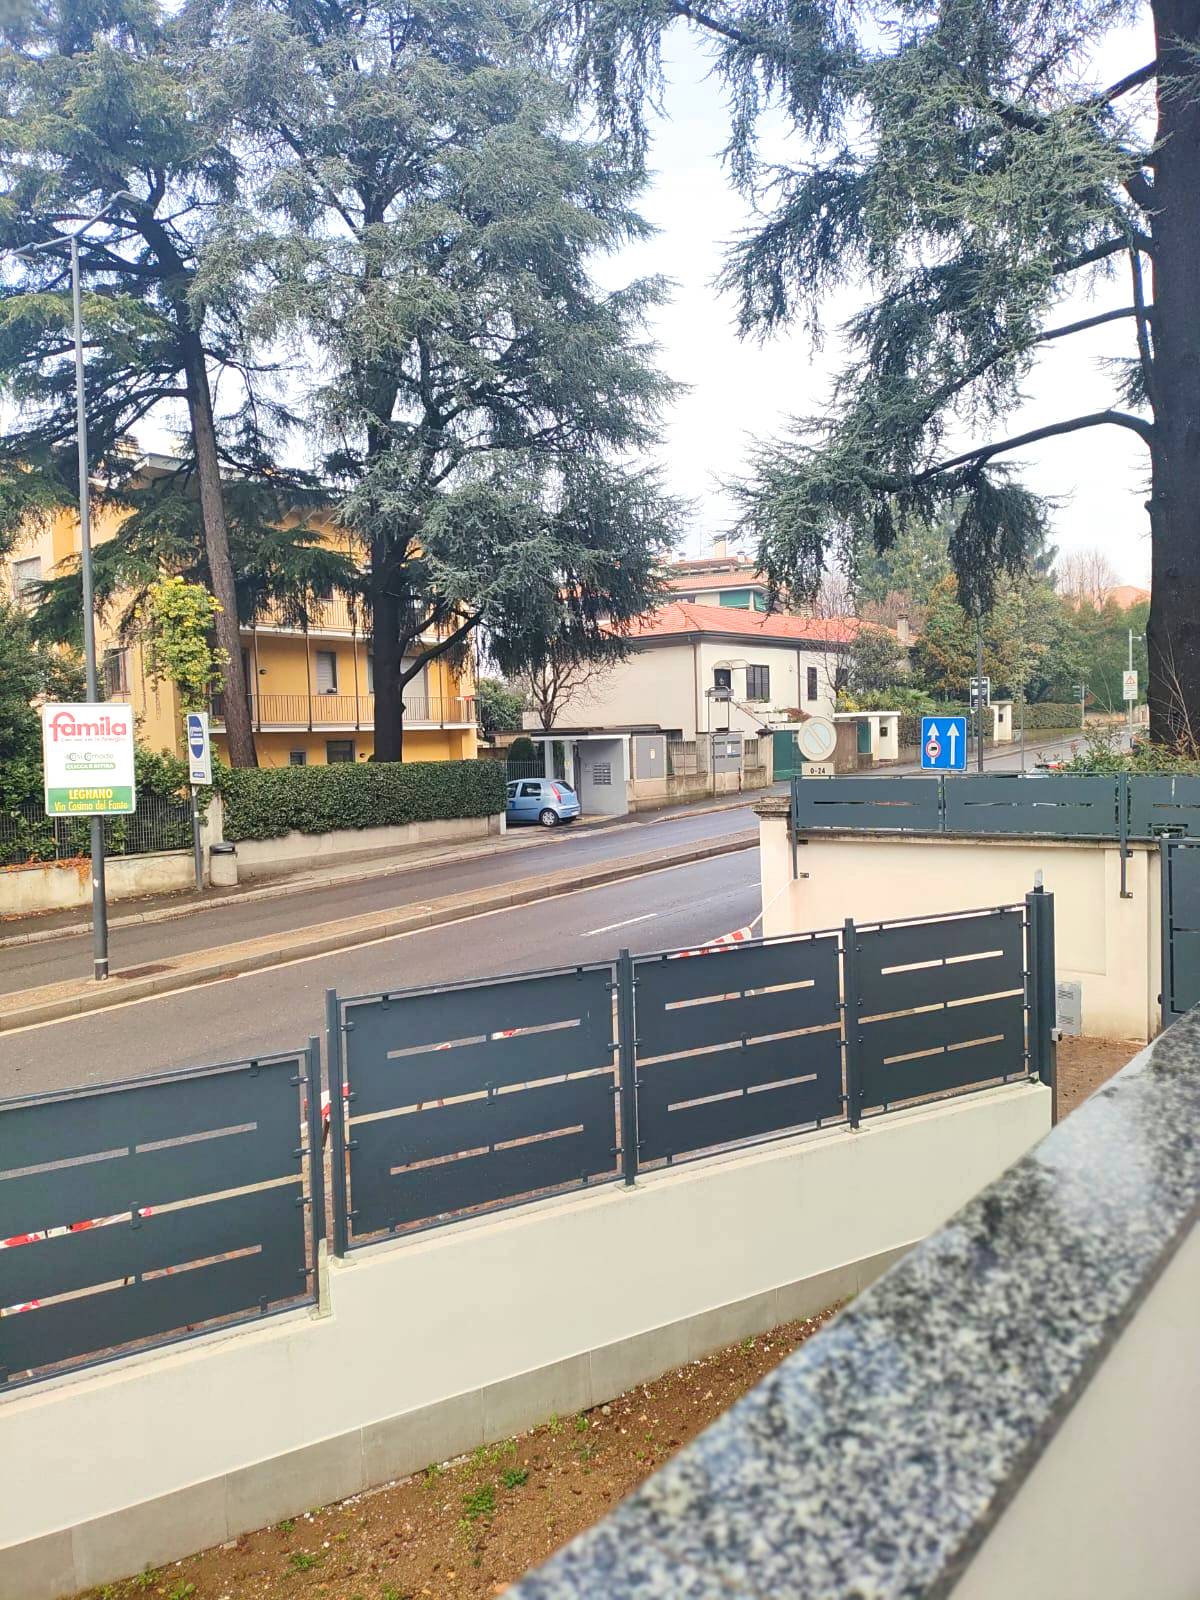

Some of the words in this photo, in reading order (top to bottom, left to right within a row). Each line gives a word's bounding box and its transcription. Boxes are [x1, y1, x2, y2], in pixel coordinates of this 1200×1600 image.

[48, 712, 127, 742] famila
[68, 788, 113, 800] LEGNANO
[54, 801, 66, 811] Via
[95, 799, 106, 809] del
